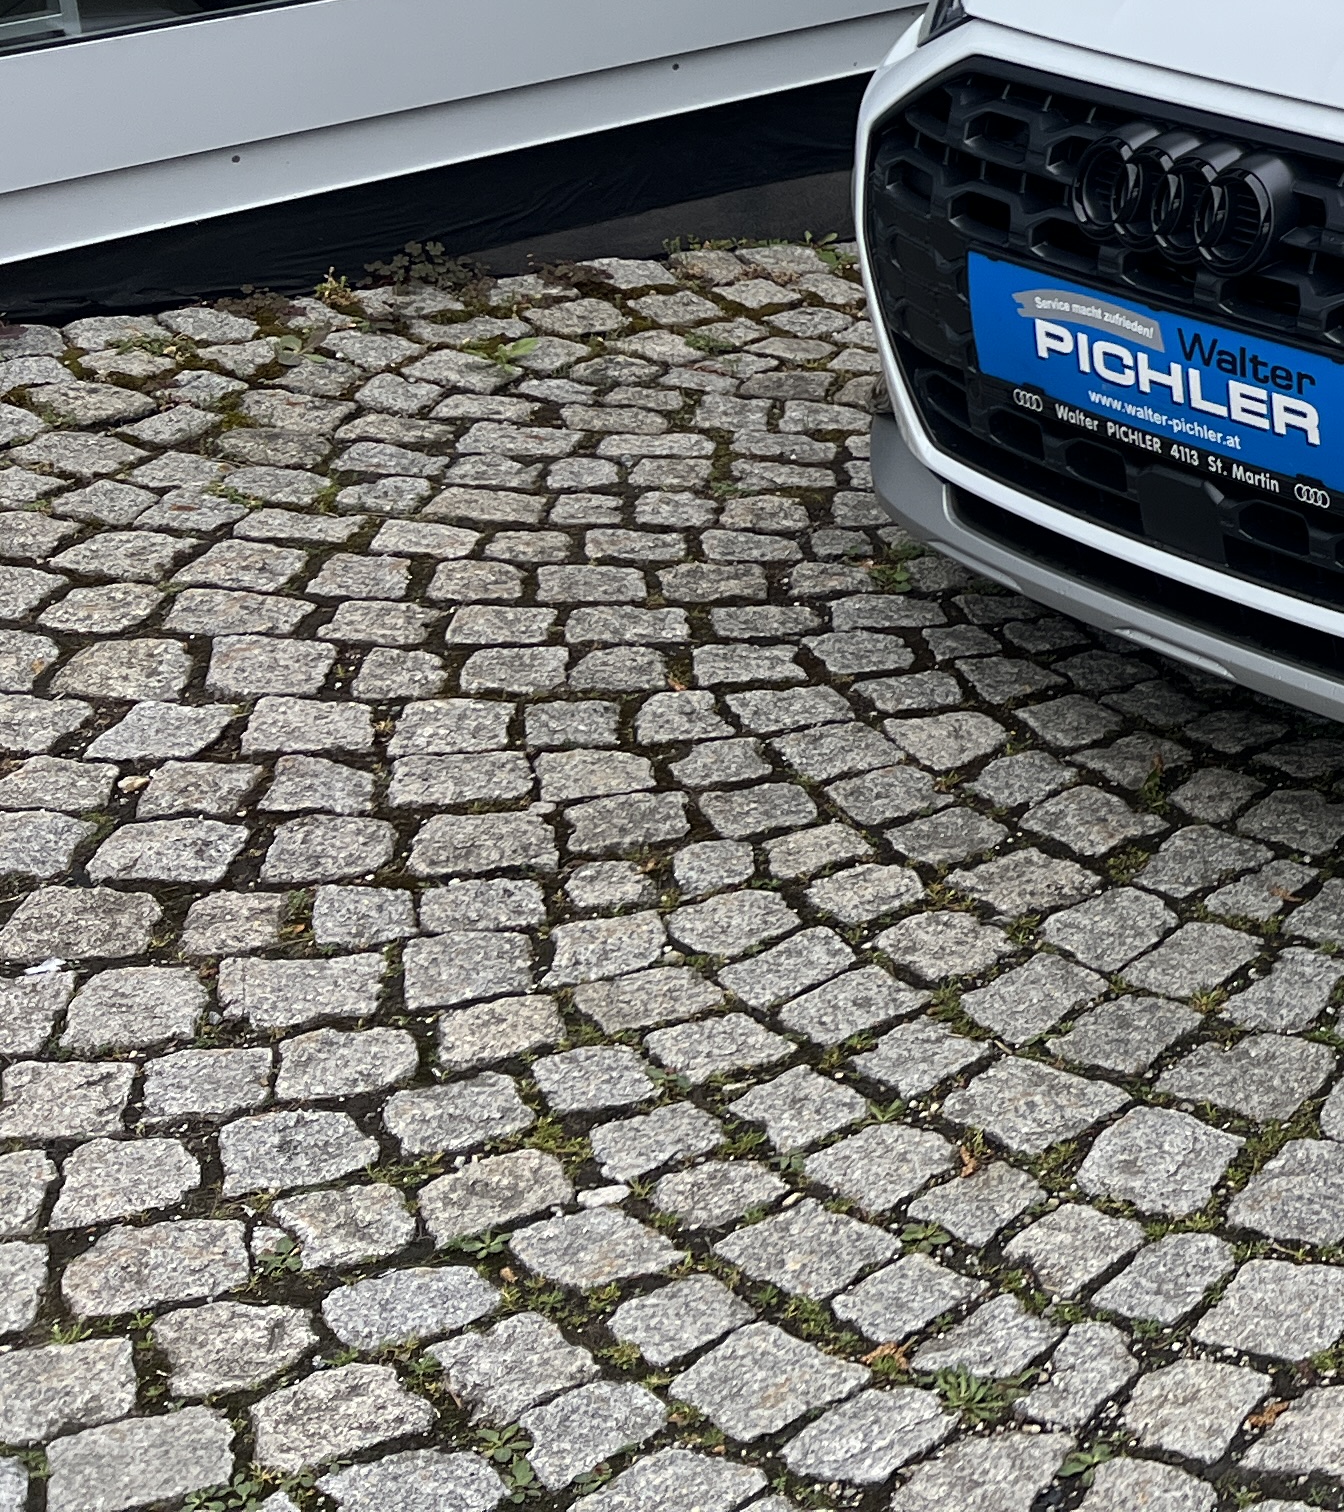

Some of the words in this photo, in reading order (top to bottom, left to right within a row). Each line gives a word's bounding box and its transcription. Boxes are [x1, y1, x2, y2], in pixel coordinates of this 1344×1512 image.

[1034, 295, 1071, 312] Service
[1071, 302, 1102, 320] macht
[1103, 310, 1154, 339] zufrieden!
[1034, 318, 1322, 446] PICHLER
[1176, 327, 1317, 396] Walter
[1054, 403, 1099, 431] Walter
[1106, 421, 1163, 454] PICHLER
[1170, 444, 1200, 466] 4113
[1207, 455, 1228, 476] St.
[1231, 463, 1280, 494] Martin
[1087, 389, 1242, 450] www.walter-pichler.at
